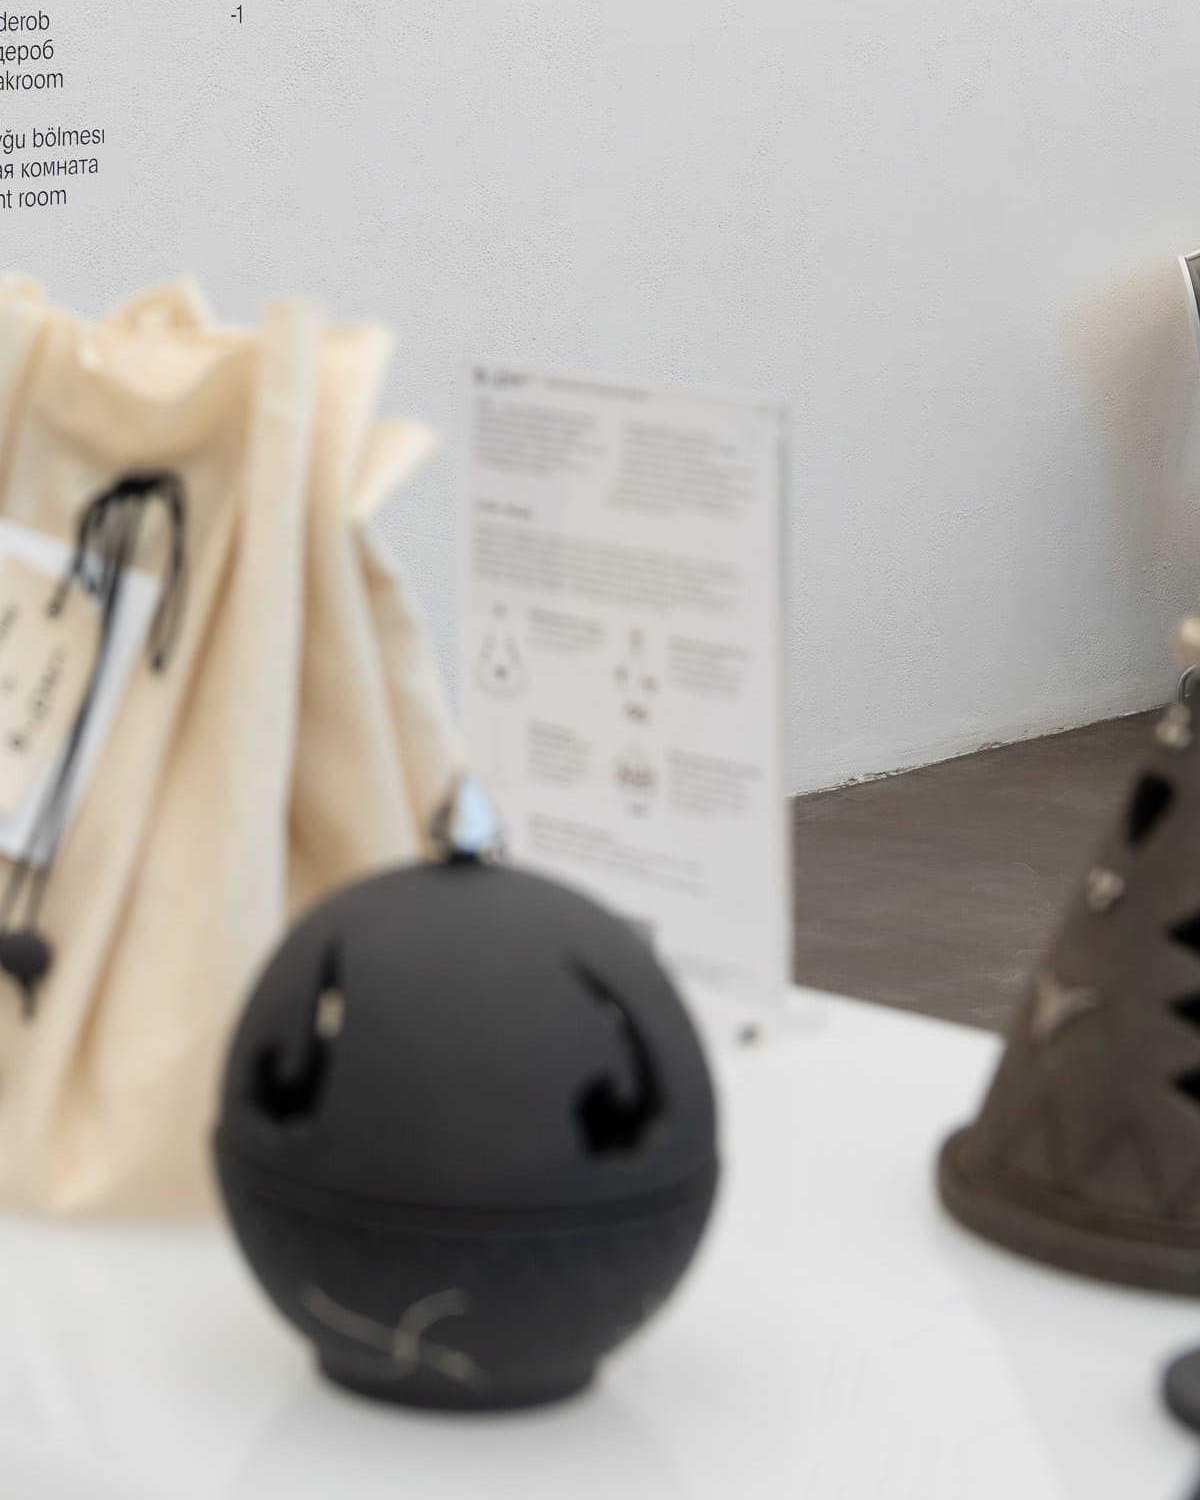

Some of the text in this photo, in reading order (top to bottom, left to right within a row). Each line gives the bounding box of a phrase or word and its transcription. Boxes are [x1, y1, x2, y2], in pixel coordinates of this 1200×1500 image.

[230, 4, 243, 25] -1
[21, 157, 99, 179] комната
[18, 188, 67, 208] room
